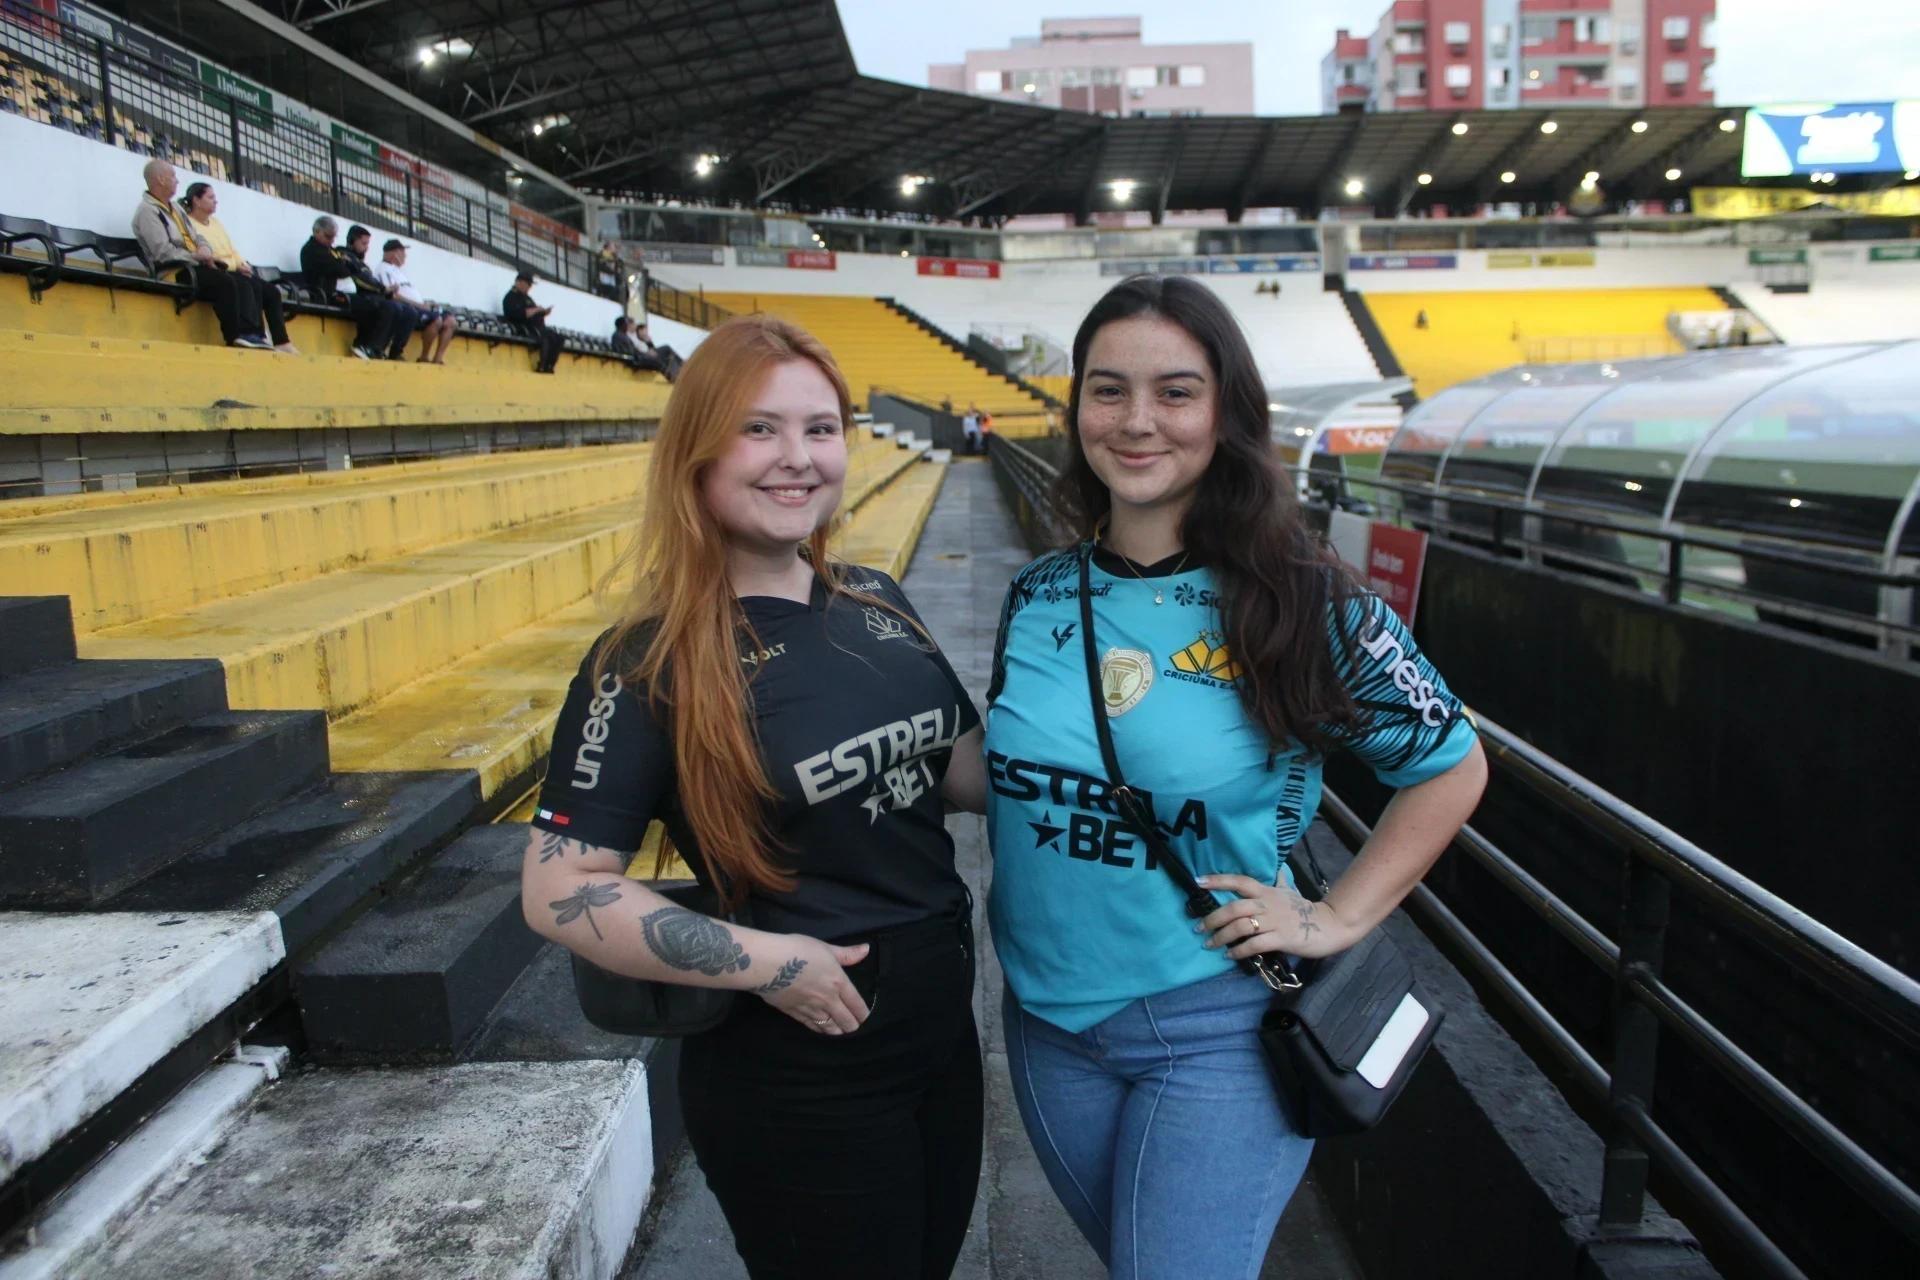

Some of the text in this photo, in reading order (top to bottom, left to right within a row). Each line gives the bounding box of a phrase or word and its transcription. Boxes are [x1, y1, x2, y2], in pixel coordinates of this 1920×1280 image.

[217, 74, 260, 105] Unimed
[1358, 616, 1450, 728] unesc
[571, 672, 622, 790] unesc
